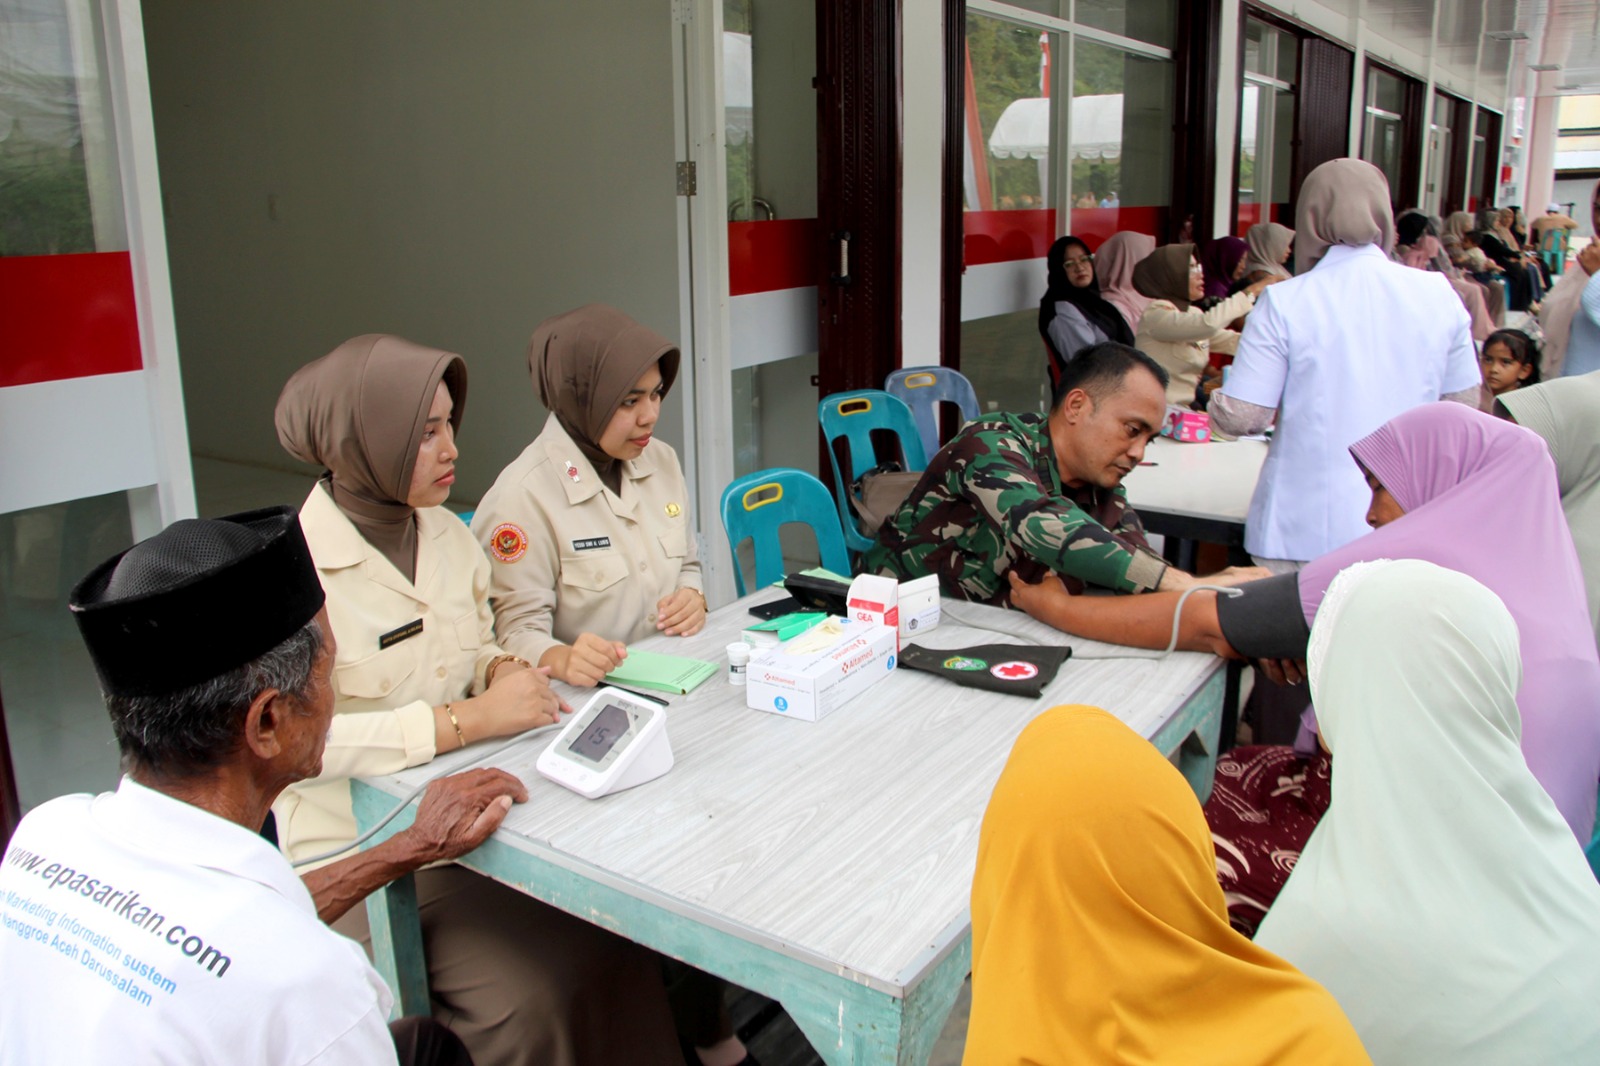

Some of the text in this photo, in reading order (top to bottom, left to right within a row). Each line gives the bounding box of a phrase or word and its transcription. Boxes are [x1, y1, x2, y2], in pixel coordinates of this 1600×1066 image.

[857, 612, 873, 623] GEA
[850, 648, 873, 668] Altamed
[6, 846, 232, 978] www.epasarikan.com
[6, 890, 178, 995] Marketing Information sustem
[50, 933, 79, 961] Aceh
[80, 949, 153, 1007] Darussalam
